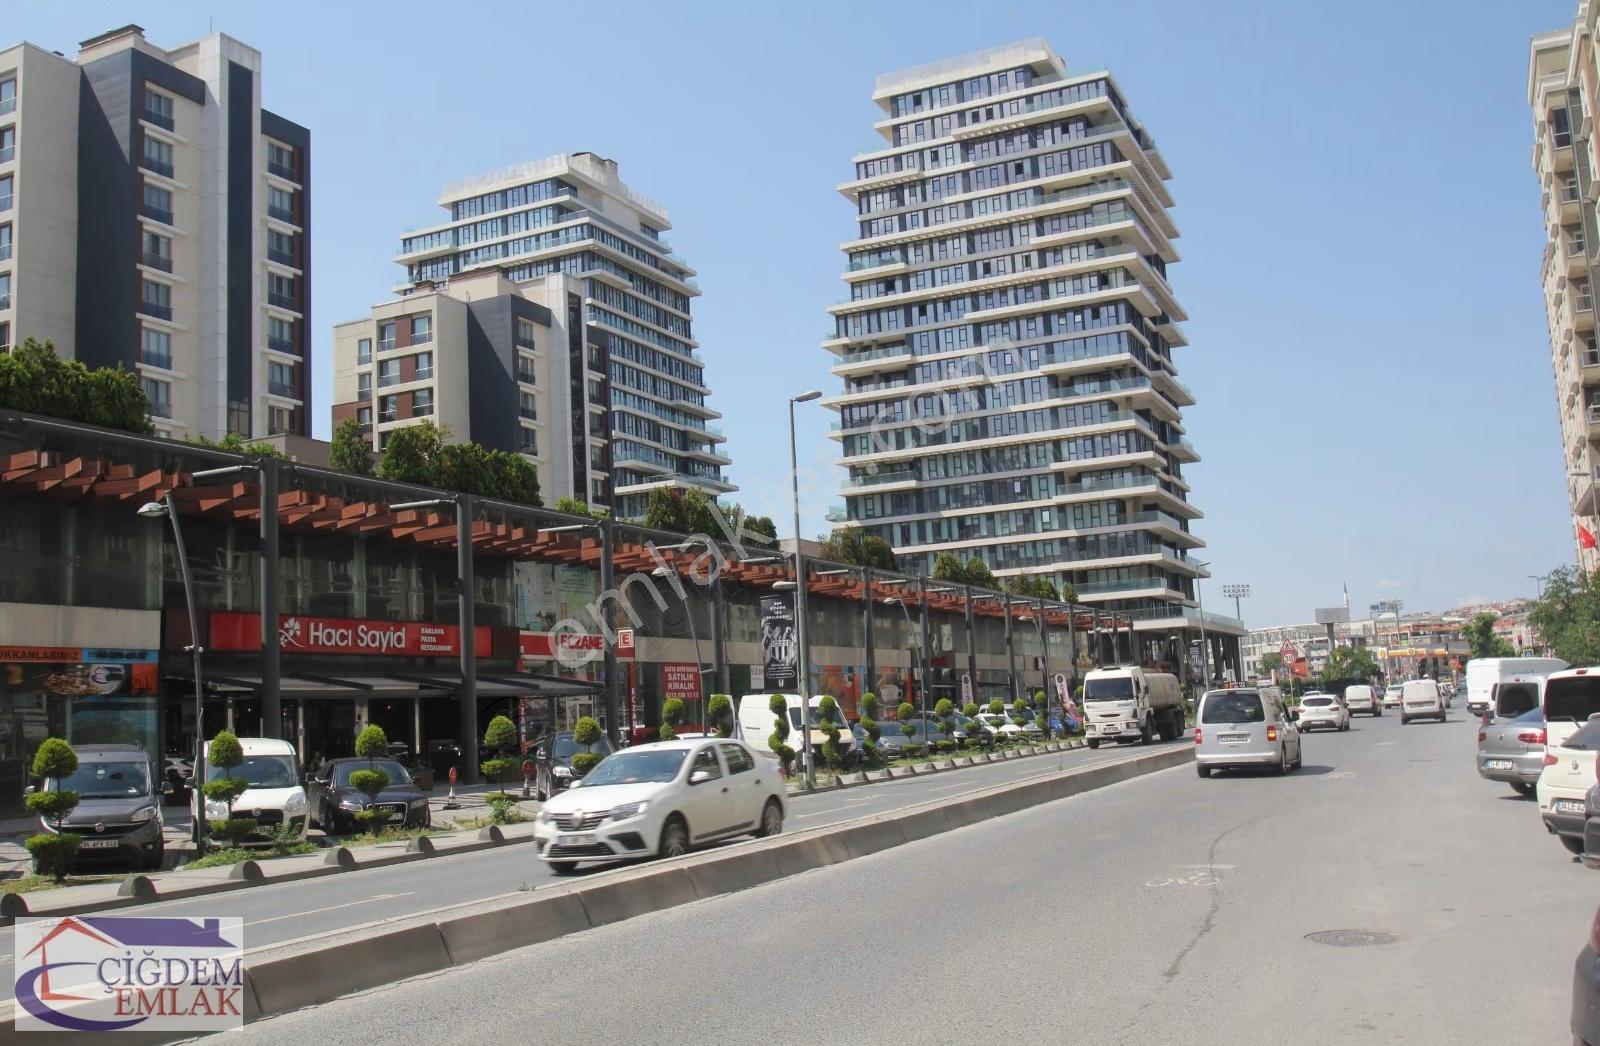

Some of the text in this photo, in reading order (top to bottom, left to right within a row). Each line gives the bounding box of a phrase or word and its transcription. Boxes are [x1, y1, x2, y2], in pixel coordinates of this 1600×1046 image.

[309, 622, 406, 652] Hacı Sayid
[420, 635, 437, 643] PASTA
[560, 634, 603, 650] ECZANE
[668, 673, 694, 681] SATILIK
[668, 681, 695, 690] KİRALIK
